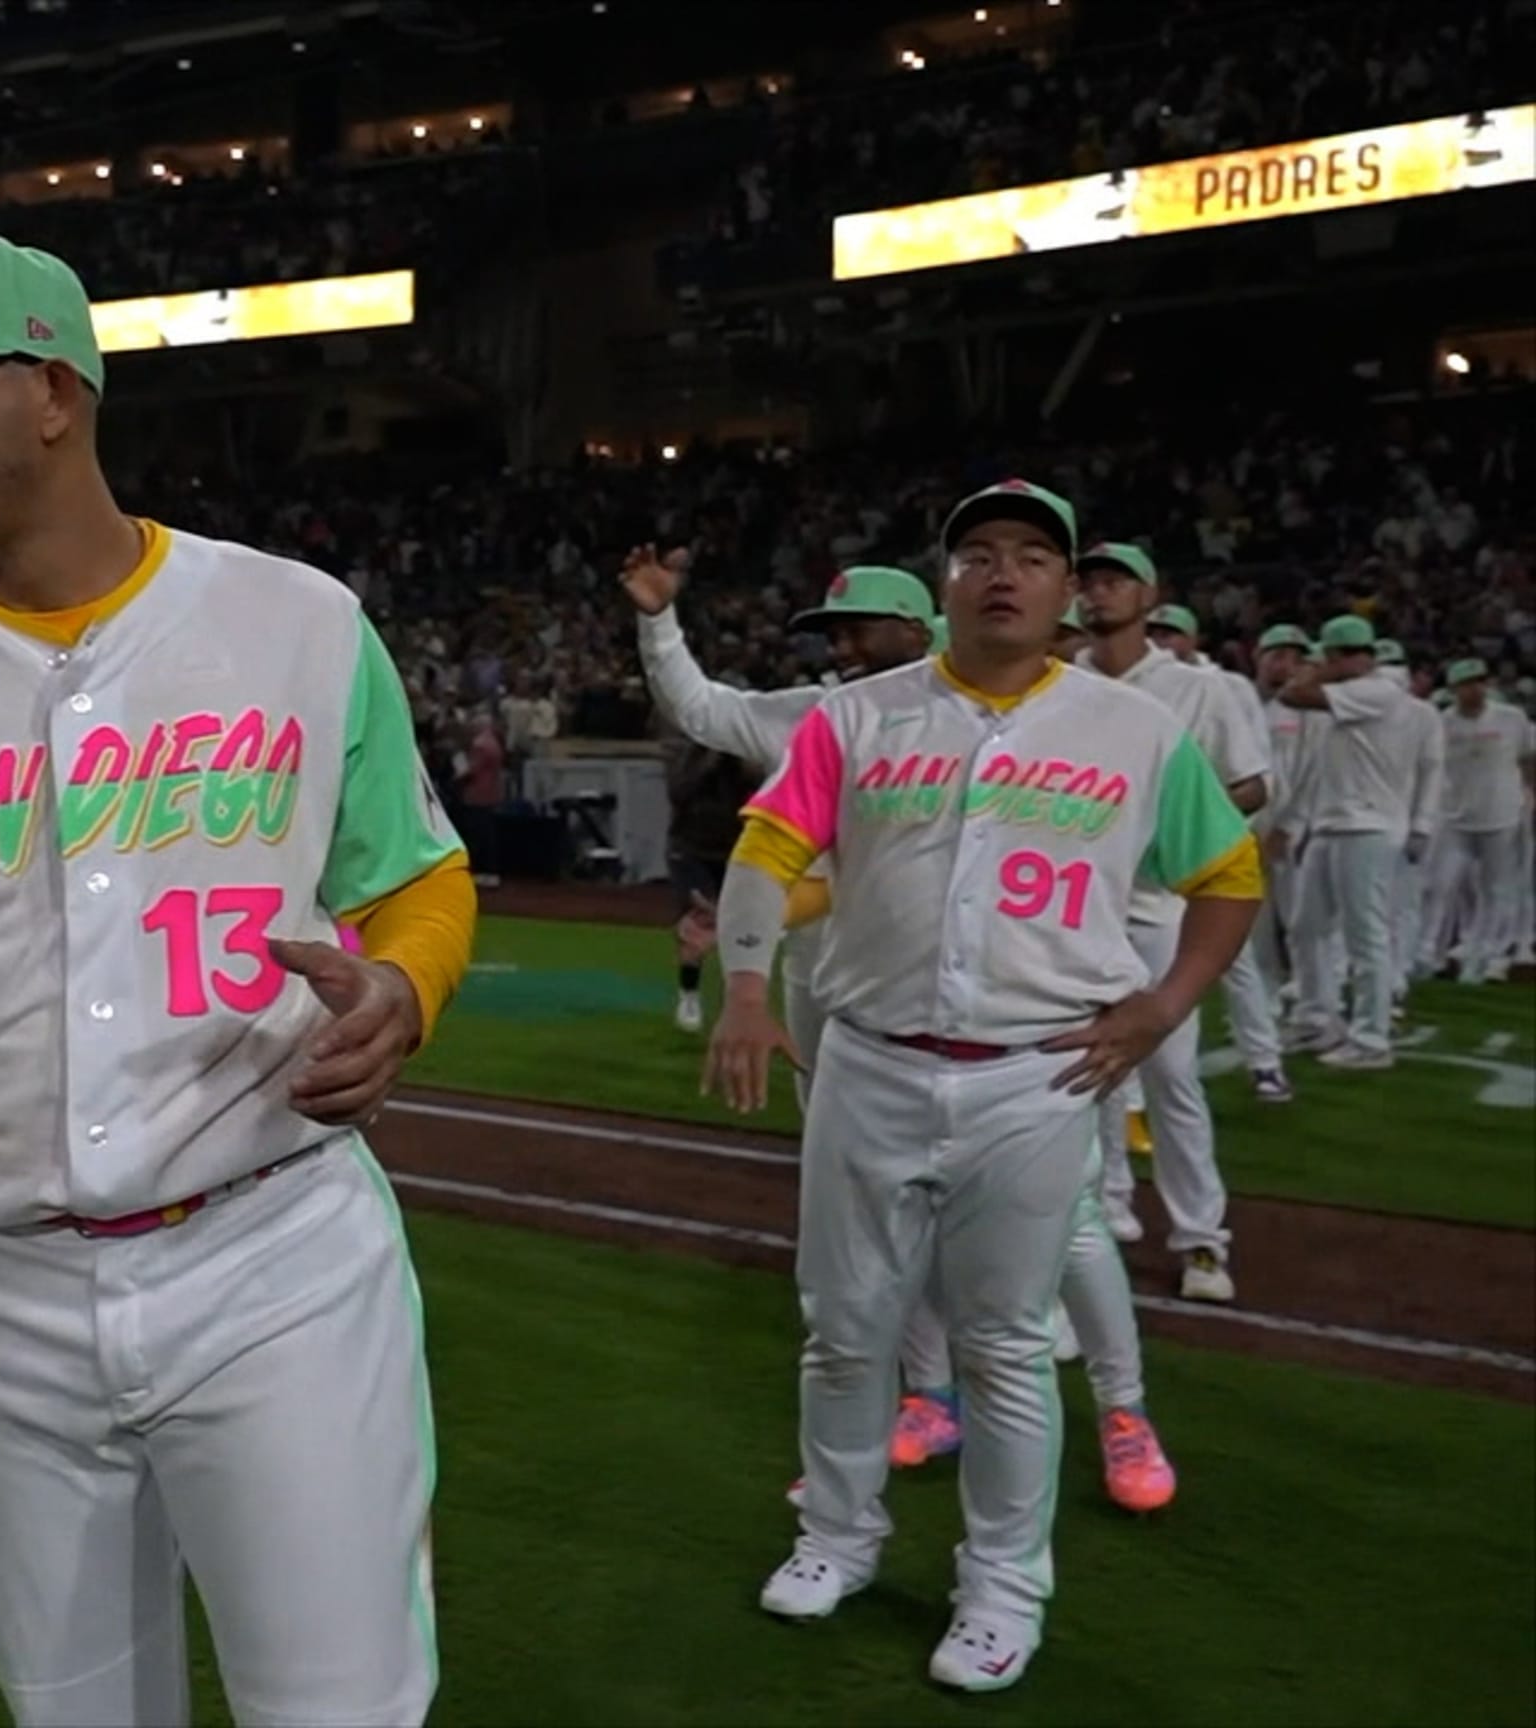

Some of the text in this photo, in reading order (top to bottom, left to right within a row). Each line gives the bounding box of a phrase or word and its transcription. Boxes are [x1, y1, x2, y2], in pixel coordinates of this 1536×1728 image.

[1194, 143, 1382, 215] PADRES
[61, 708, 304, 859] DIEGO
[856, 753, 1129, 839] SAN DIEGO
[995, 849, 1093, 931] 91
[141, 886, 287, 1018] 13
